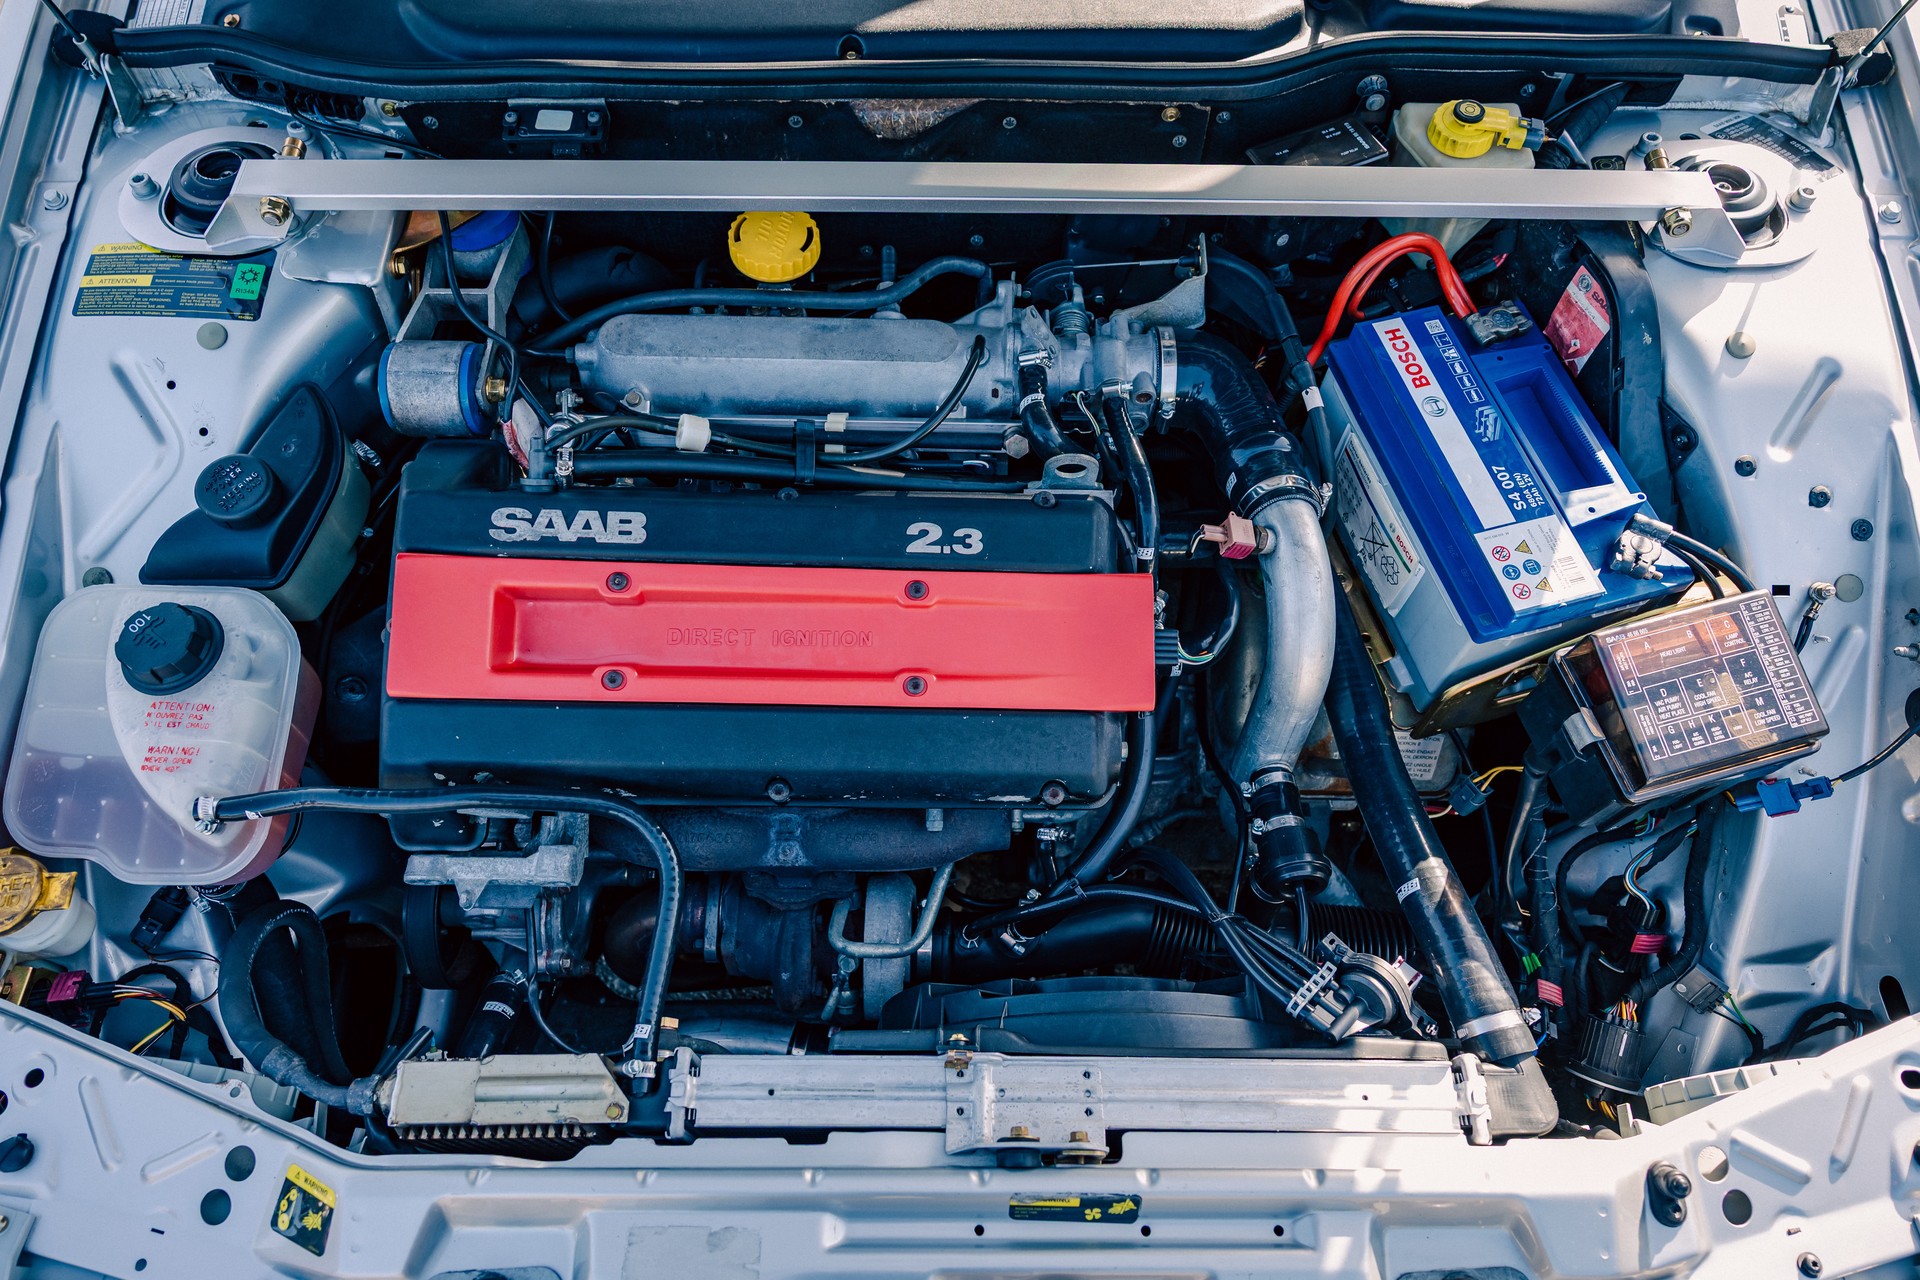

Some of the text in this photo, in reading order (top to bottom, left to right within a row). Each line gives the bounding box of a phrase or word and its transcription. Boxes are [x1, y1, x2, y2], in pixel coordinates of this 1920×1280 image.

[755, 218, 772, 240] OIL
[769, 211, 795, 259] MOTOR
[1384, 328, 1431, 389] BOSCH
[202, 457, 240, 492] APPROVED
[212, 465, 242, 494] POWER
[217, 469, 258, 507] STEERING
[222, 475, 264, 512] FLUID ONLY
[1492, 465, 1526, 511] S4 007
[1513, 472, 1538, 508] 680A (EN)
[1522, 473, 1545, 506] 72Ah 12V
[488, 507, 647, 544] SAAB
[906, 521, 984, 555] 2.3
[1396, 534, 1414, 564] BOSCH
[128, 614, 151, 633] 100
[1724, 620, 1730, 628] C
[666, 628, 874, 648] DIRECT IGNITION
[1606, 634, 1625, 643] SAAB
[1686, 630, 1693, 638] B
[1644, 642, 1651, 650] A
[1724, 638, 1746, 648] CONTROL
[1740, 658, 1746, 667] F
[1696, 679, 1703, 687] E
[1744, 677, 1758, 685] RELAY
[1660, 689, 1667, 697] D
[1707, 696, 1721, 705] SPEED
[1755, 697, 1764, 706] M
[150, 701, 214, 712] ATTENTION!
[1672, 708, 1686, 717] PLATE
[1754, 708, 1777, 719] COOL.FAN
[1688, 720, 1695, 728] H
[1708, 714, 1716, 723] K
[1754, 714, 1781, 726] LOW SPEED
[1668, 726, 1675, 734] G
[148, 746, 200, 756] WARNING!
[304, 1176, 328, 1195] WARNING
